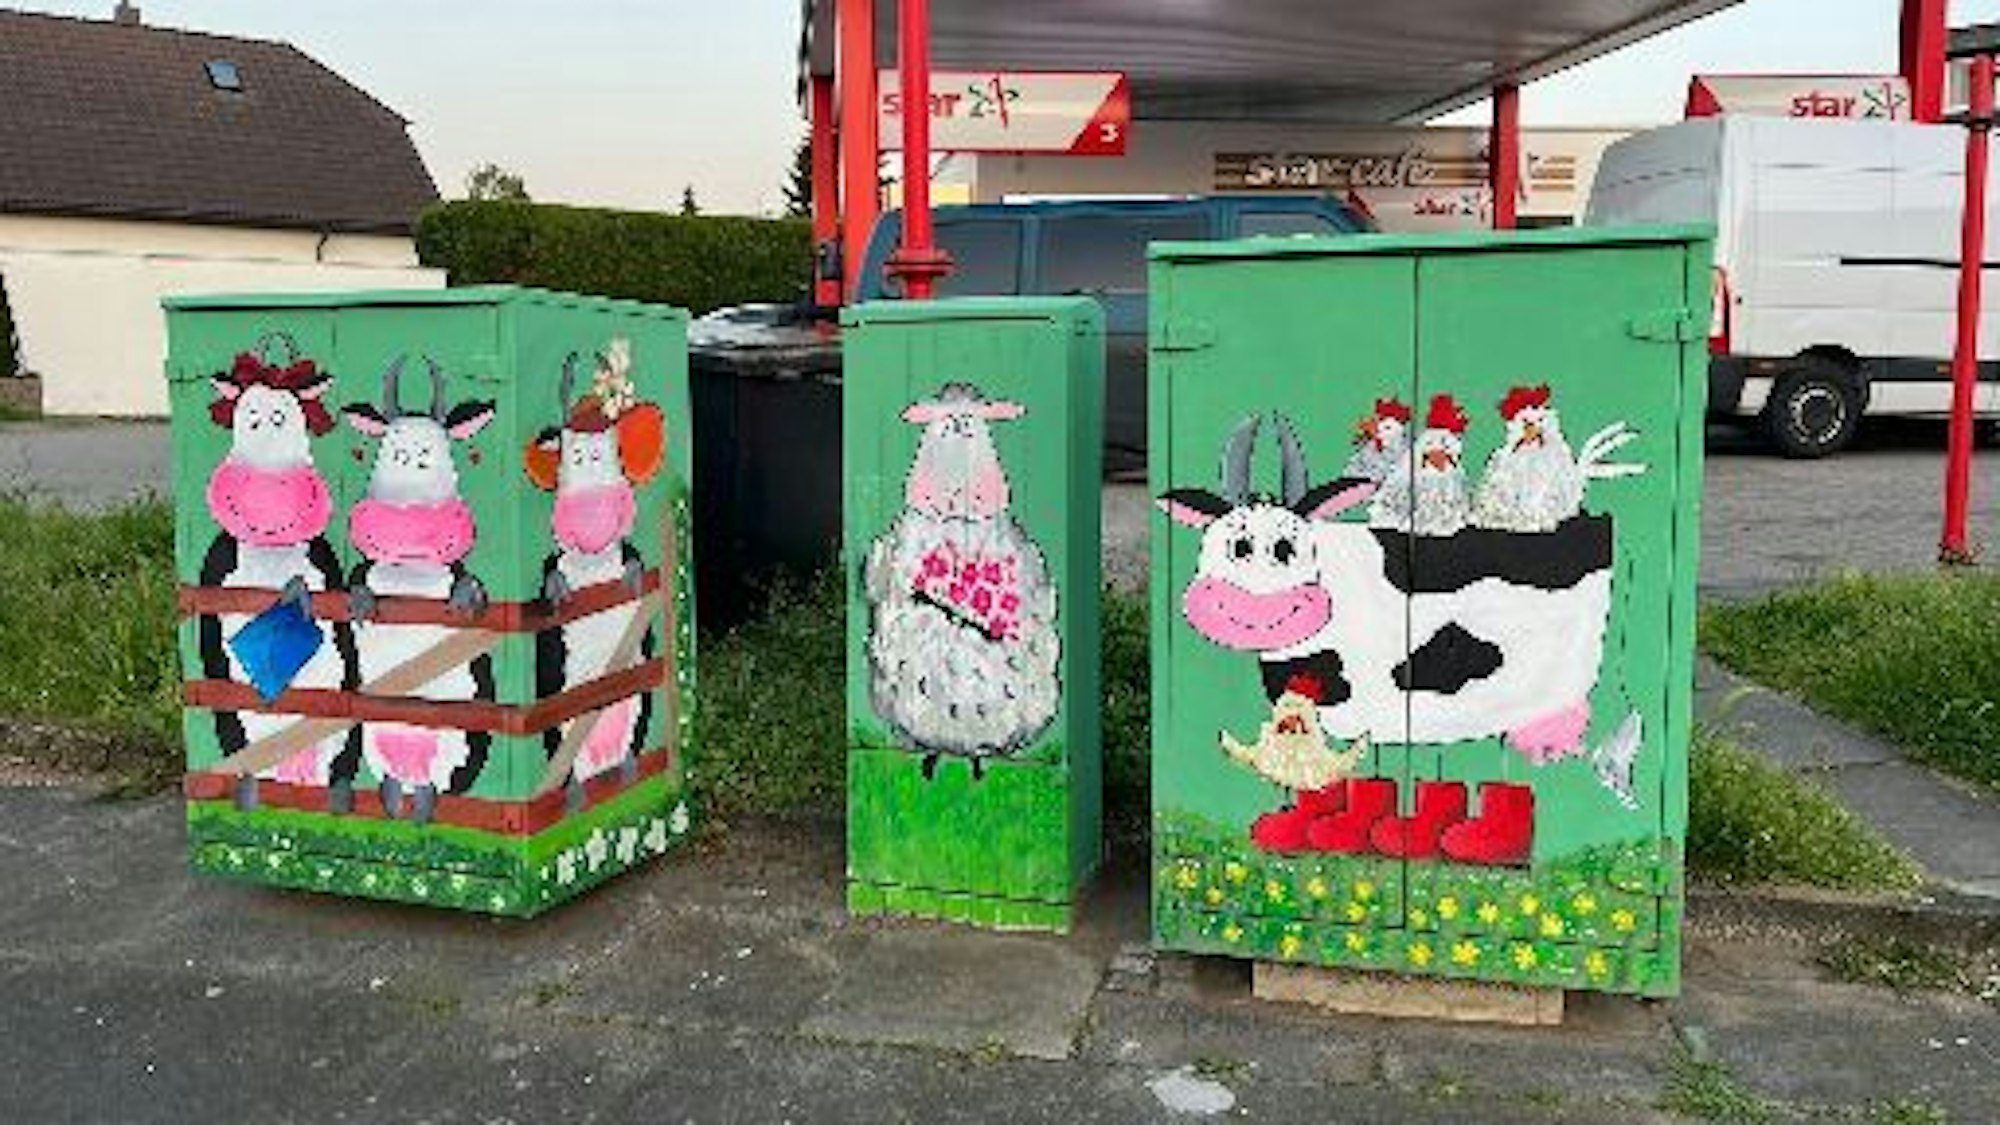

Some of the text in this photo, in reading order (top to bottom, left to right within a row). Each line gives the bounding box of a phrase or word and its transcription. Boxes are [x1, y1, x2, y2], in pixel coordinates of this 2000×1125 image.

[882, 93, 961, 117] sar
[1792, 89, 1856, 117] star
[1099, 123, 1119, 142] 3
